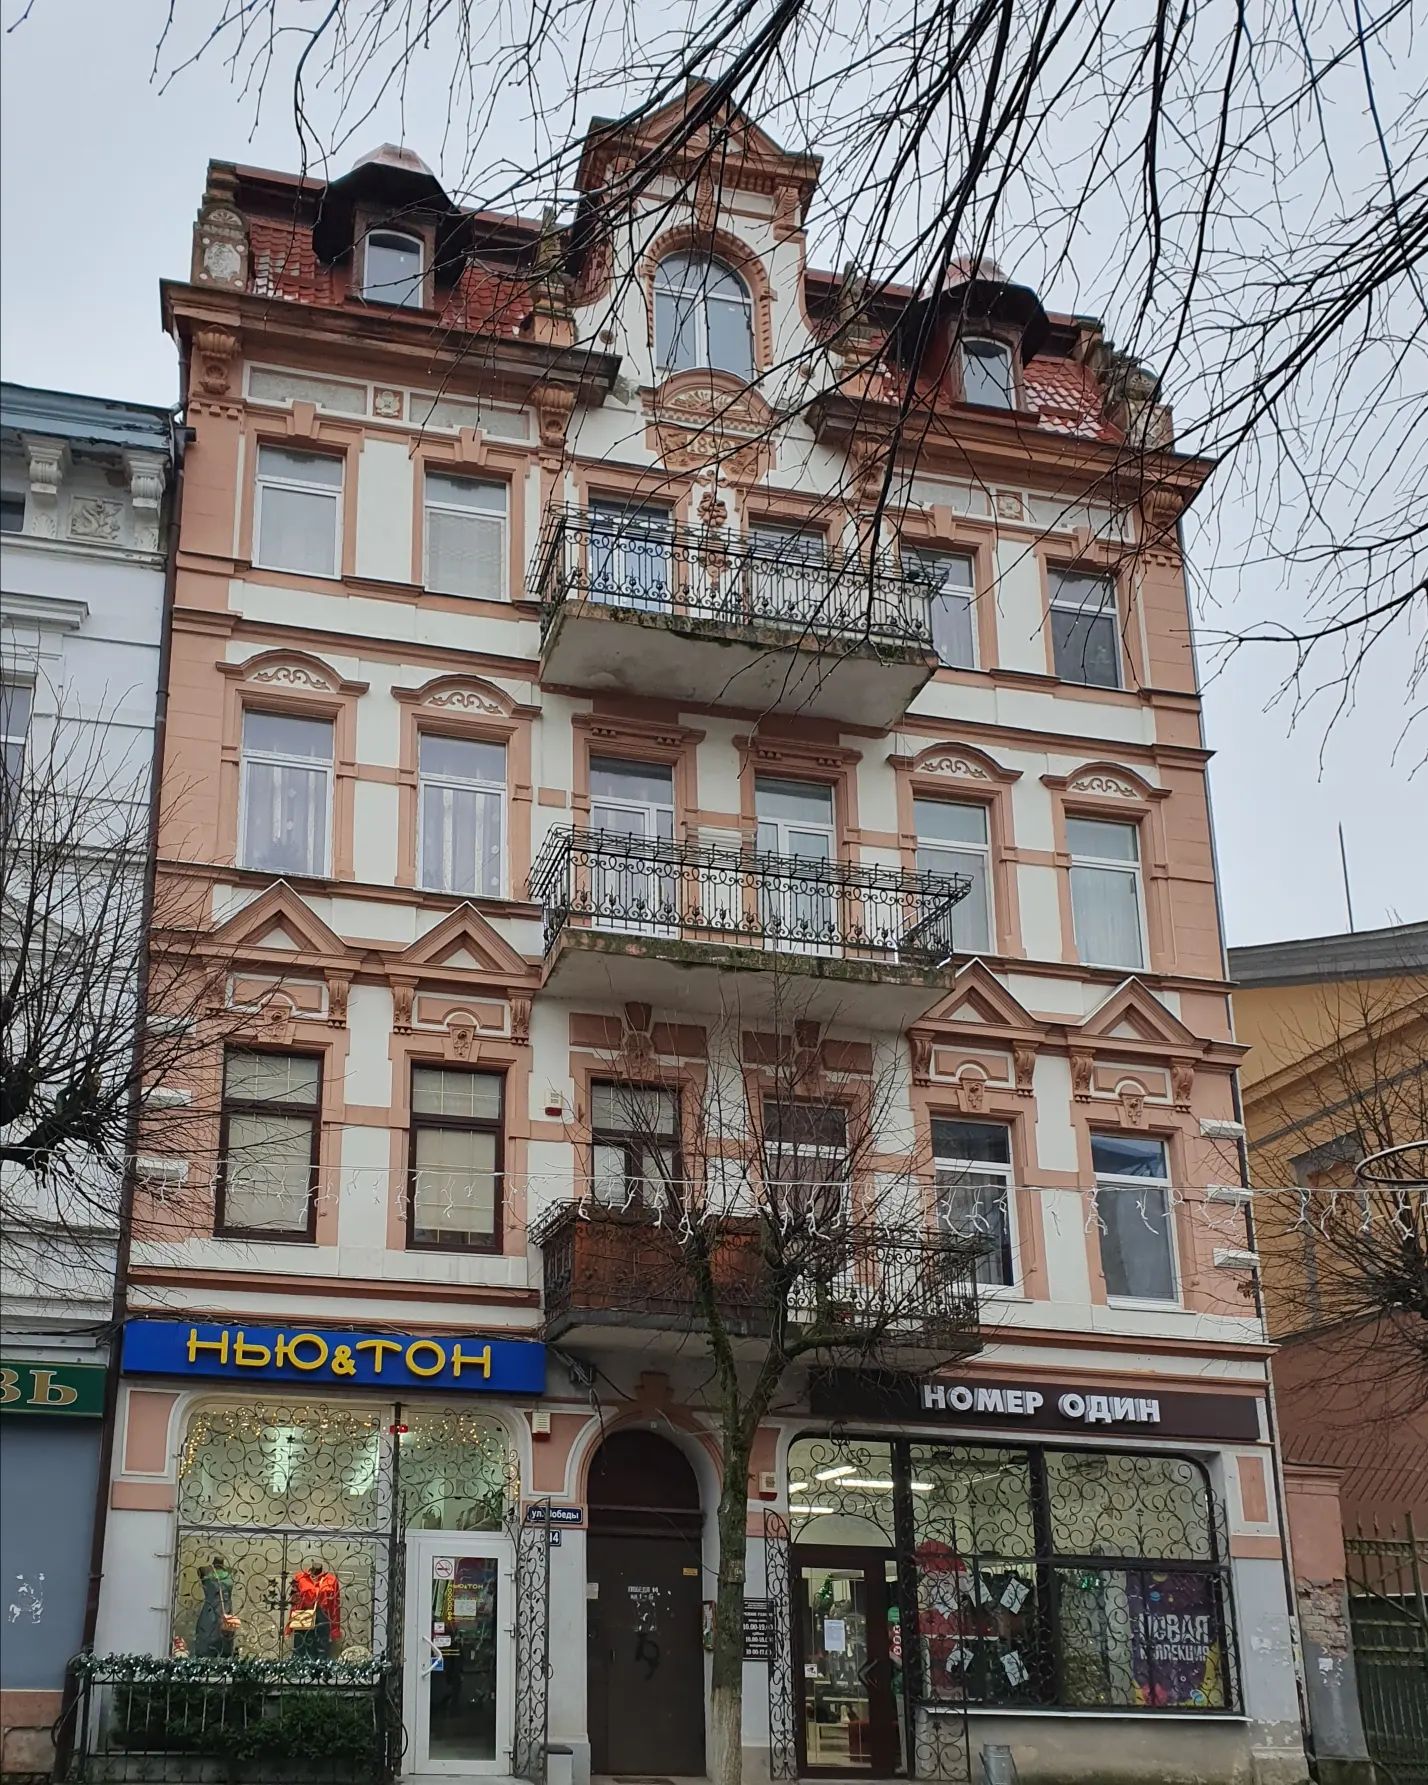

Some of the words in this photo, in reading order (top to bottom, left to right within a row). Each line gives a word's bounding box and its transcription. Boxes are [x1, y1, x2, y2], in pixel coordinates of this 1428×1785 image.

[187, 1329, 491, 1378] НЬЮ&ТОН
[922, 1385, 1043, 1415] НОМЕР
[1058, 1393, 1160, 1423] ОДИН
[531, 1510, 544, 1519] ул.
[549, 1532, 559, 1543] 14
[1138, 1613, 1210, 1643] НОВАЯ
[1140, 1644, 1209, 1662] КЛЛЕКЦИЯ
